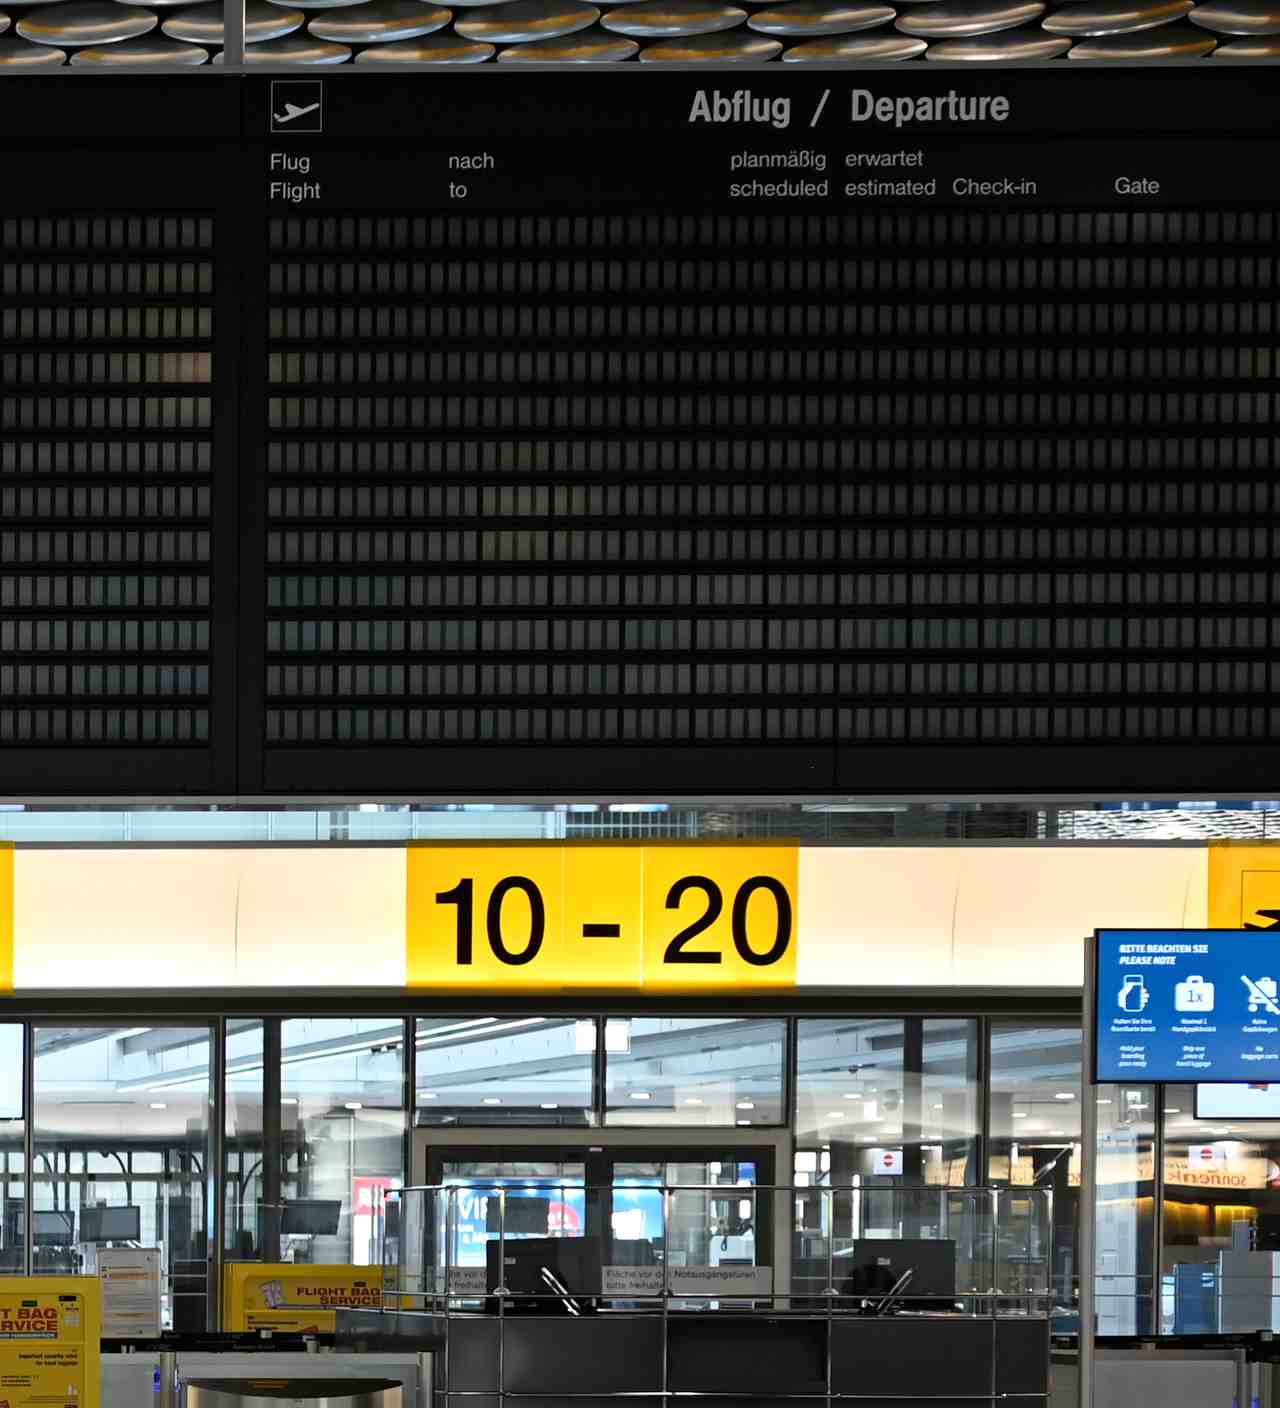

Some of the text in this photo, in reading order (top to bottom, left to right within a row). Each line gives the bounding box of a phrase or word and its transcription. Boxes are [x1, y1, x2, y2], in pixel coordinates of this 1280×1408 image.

[688, 89, 1010, 129] Abflug / Departure
[270, 150, 923, 174] Flug nach planmäßig erwartet
[270, 176, 1160, 203] Flight to scheduled estimated Check-in Gate
[435, 875, 792, 967] 10 - 20
[297, 1287, 382, 1297] FLIGHT BAG
[320, 1296, 382, 1305] SERVICE
[18, 1308, 58, 1320] BAG
